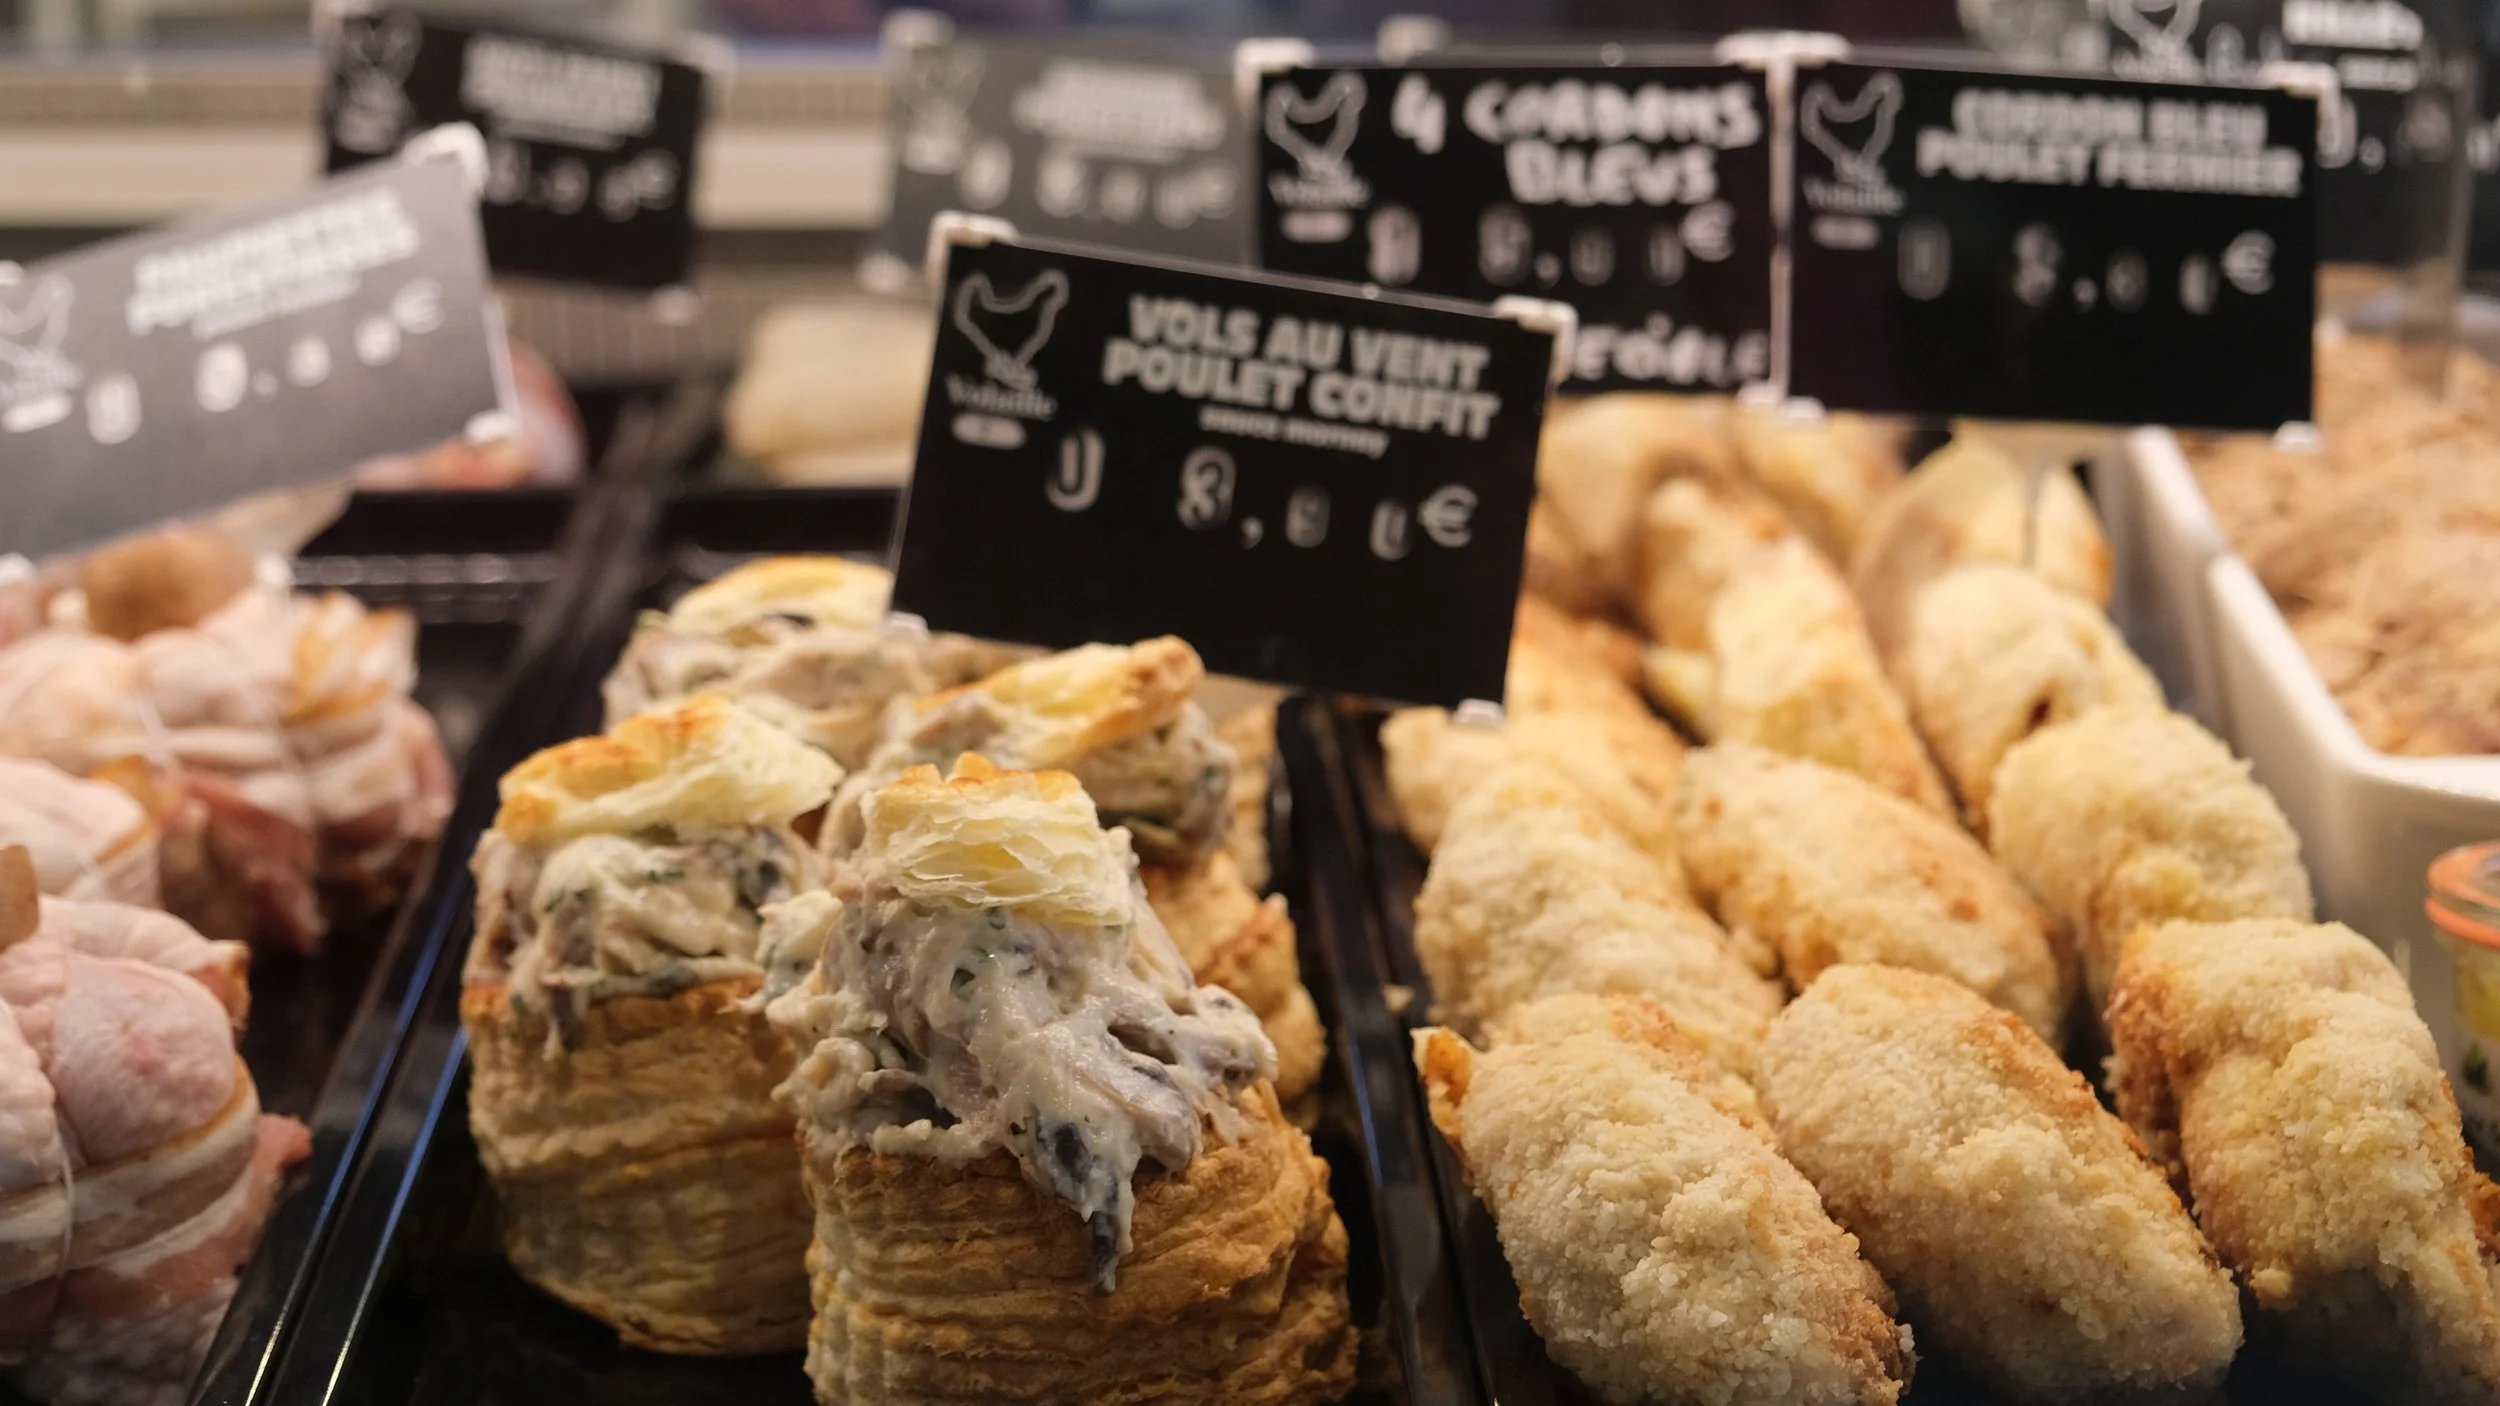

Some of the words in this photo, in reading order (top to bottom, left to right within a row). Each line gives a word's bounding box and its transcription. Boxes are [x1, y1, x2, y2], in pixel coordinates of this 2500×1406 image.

[1390, 72, 1448, 155] 4
[1101, 338, 1306, 412] POULET
[1307, 369, 1501, 442] CONFIT
[1128, 293, 1262, 359] VOLS
[1263, 316, 1345, 372] AU
[1349, 326, 1491, 391] VENT
